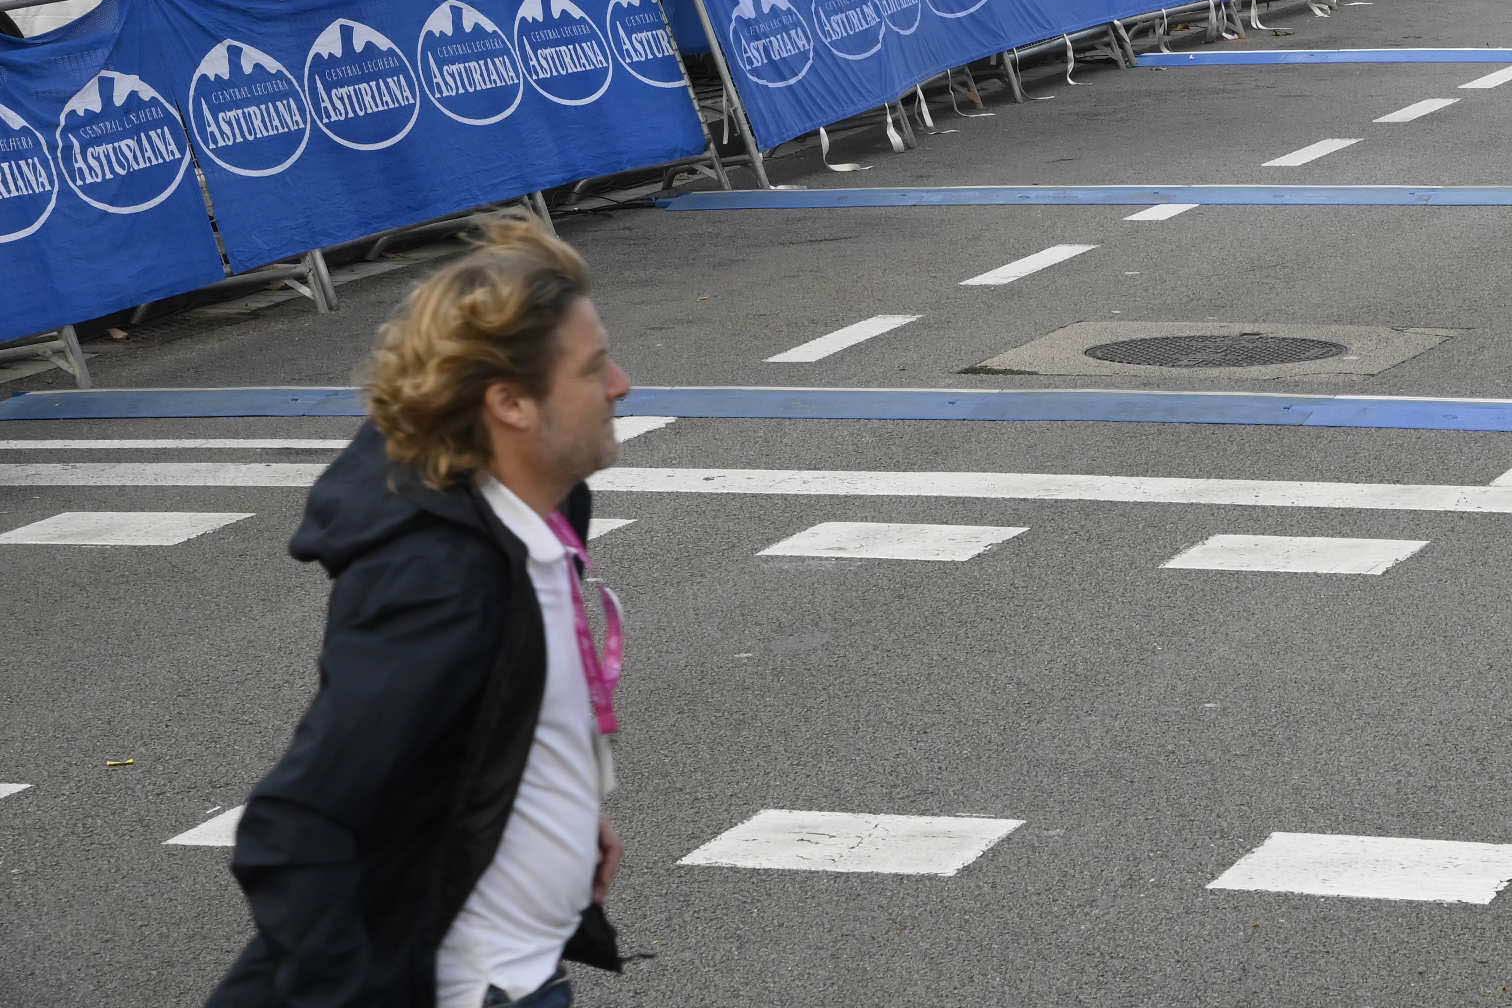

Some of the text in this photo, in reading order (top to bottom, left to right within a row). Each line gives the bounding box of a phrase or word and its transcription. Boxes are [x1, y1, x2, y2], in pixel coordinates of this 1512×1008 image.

[325, 64, 360, 81] CENTRAL
[427, 49, 520, 99] ASTURIANA
[522, 35, 609, 80] ASTURIANA
[211, 88, 251, 105] CENTRAL
[315, 72, 416, 124] ASTURIANA
[201, 97, 305, 149] ASTURIANA
